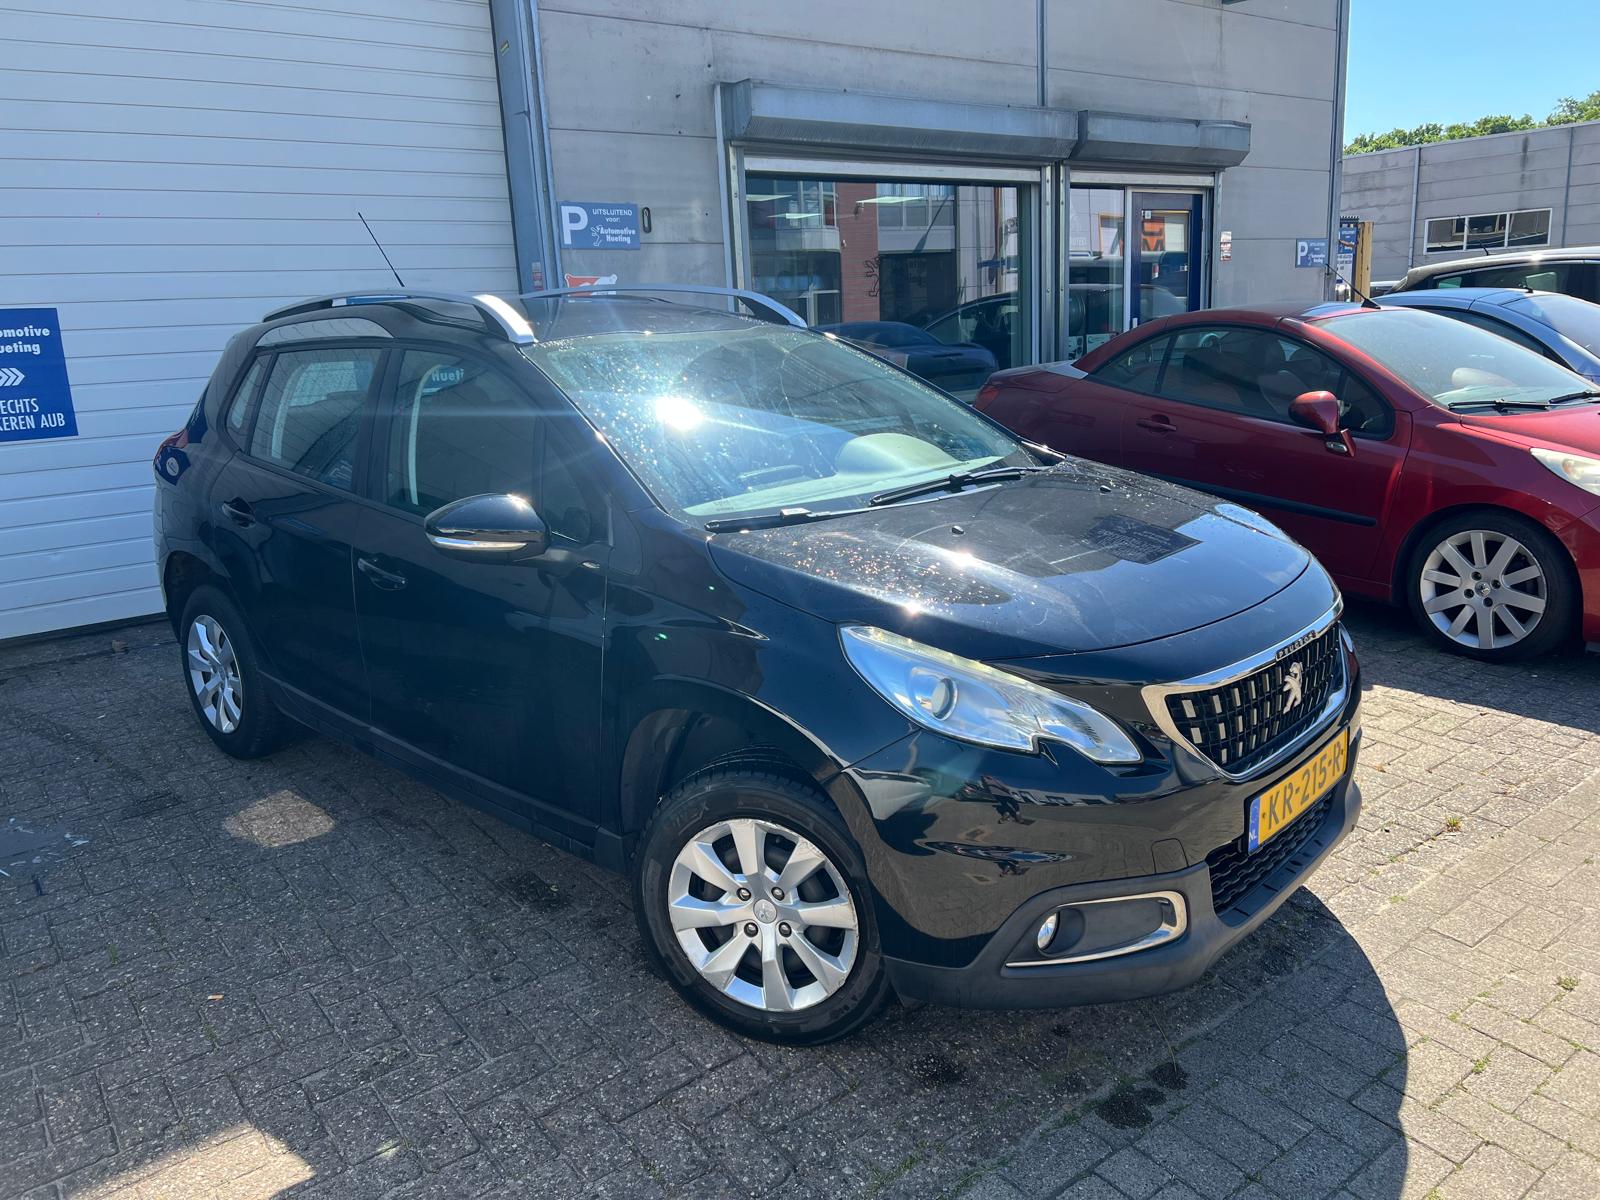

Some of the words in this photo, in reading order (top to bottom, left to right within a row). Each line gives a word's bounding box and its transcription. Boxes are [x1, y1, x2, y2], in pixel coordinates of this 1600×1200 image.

[592, 208, 633, 216] UITSLUITEND
[561, 205, 588, 245] P
[600, 226, 636, 235] Automotive
[606, 235, 631, 244] Hueting
[1297, 241, 1308, 266] P
[41, 412, 66, 429] AUB
